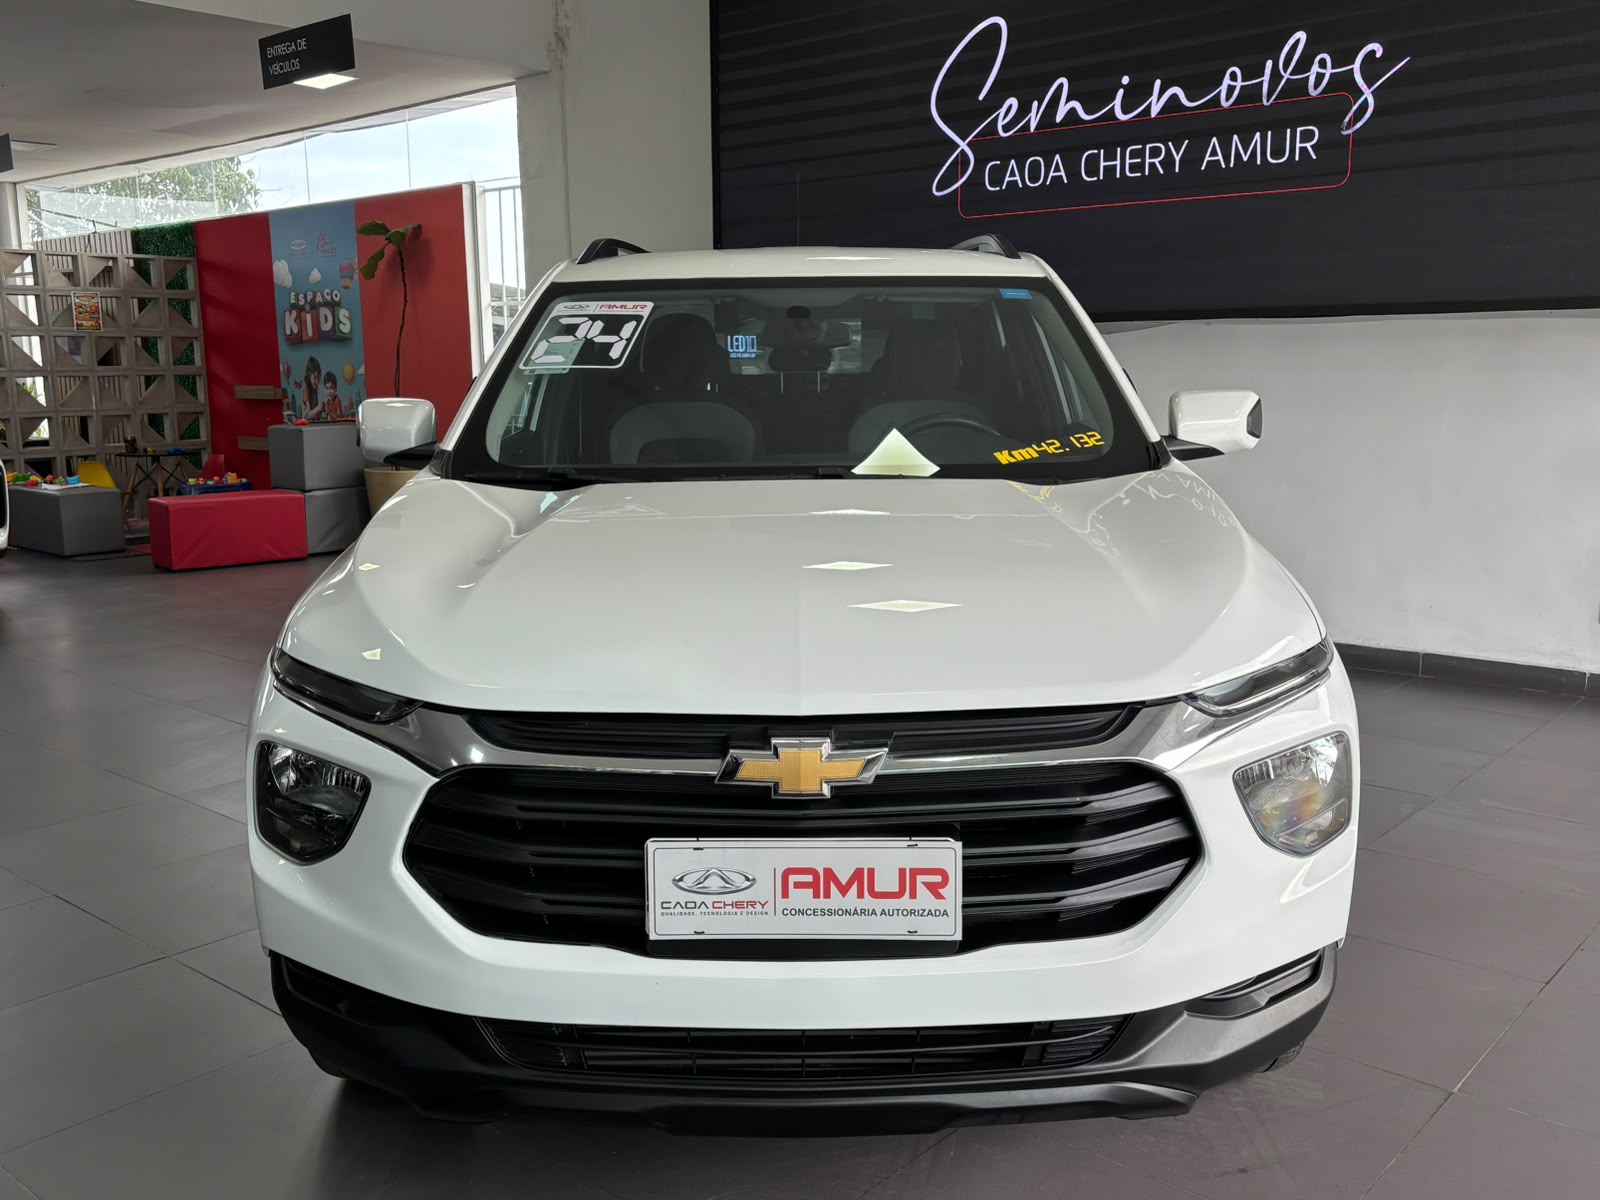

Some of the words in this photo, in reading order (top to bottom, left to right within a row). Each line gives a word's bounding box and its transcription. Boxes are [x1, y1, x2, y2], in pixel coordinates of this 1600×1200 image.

[267, 42, 296, 58] ENTREGA
[297, 38, 307, 51] DE
[268, 58, 300, 76] VEÍCULOS
[930, 16, 1411, 196] Seminovos
[985, 154, 1068, 191] CAOA
[1081, 140, 1189, 181] CHERY
[1201, 125, 1319, 171] AMUR
[284, 307, 352, 337] KIDS
[530, 316, 637, 360] 24
[781, 867, 950, 900] AMUR
[660, 900, 710, 910] CAOA
[711, 900, 769, 910] CHERY
[781, 906, 878, 917] CONCESSIONÁRIA
[879, 908, 950, 918] AUTORIZADA
